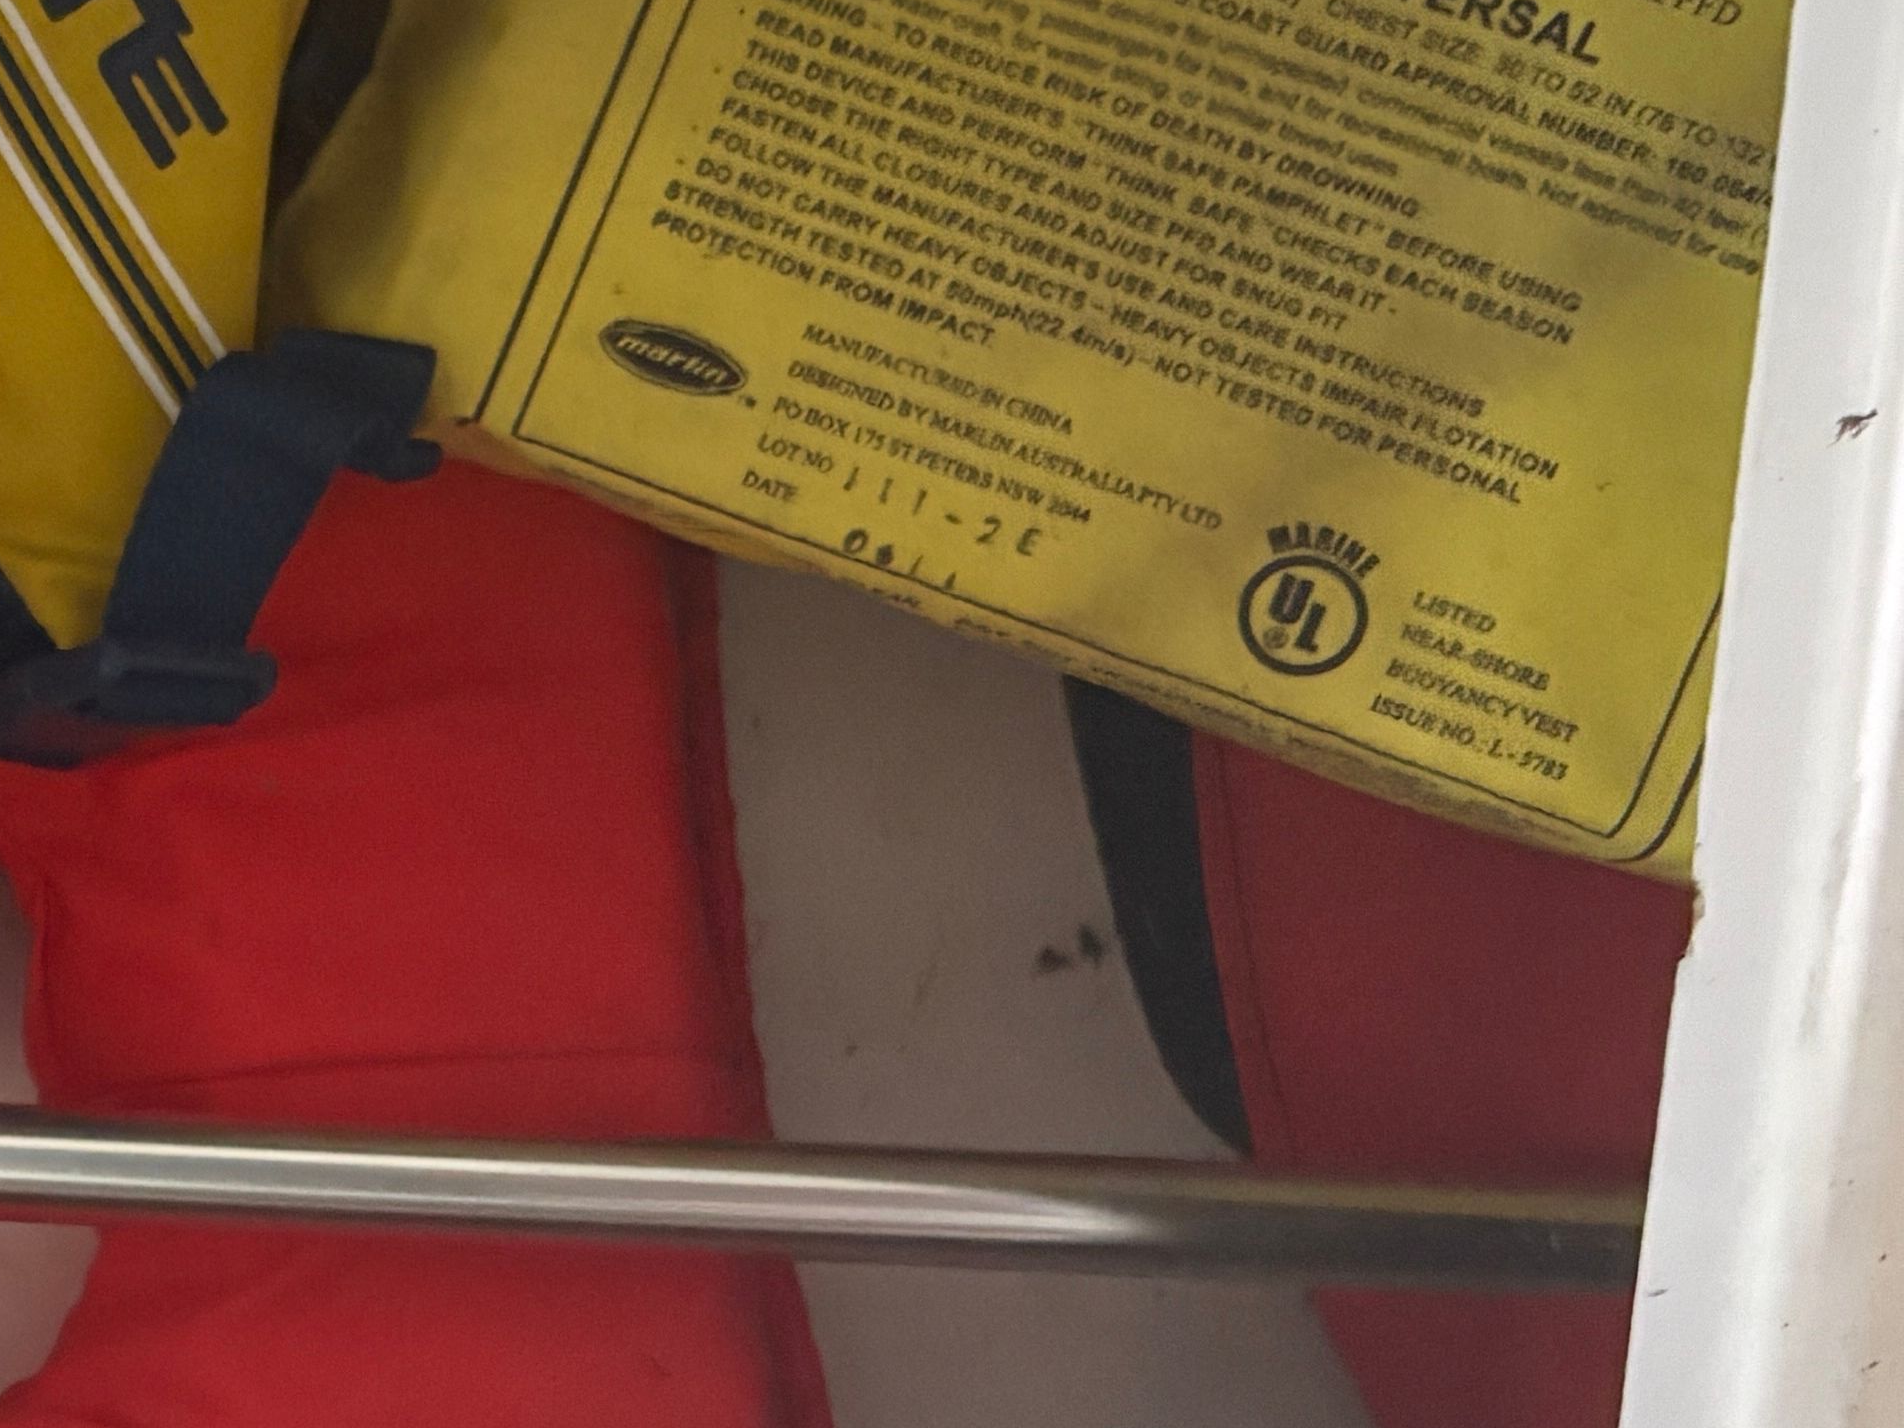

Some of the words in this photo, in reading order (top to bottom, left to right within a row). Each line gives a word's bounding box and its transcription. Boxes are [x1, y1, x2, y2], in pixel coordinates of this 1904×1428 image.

[892, 23, 927, 47] TO
[930, 36, 1039, 85] REDUCE
[1042, 73, 1105, 107] RISK
[1111, 96, 1146, 121] OF
[1149, 109, 1234, 151] DEATH
[1237, 140, 1273, 165] BY
[1294, 27, 1389, 72] GUARD
[1392, 61, 1532, 122] APPROVAL
[1323, 0, 1415, 46] CHEST
[1528, 71, 1564, 97] TO
[1565, 84, 1599, 110] 52
[1602, 97, 1630, 121] IN
[1680, 124, 1715, 150] TO
[721, 99, 817, 144] FASTEN
[820, 133, 868, 162] ALL
[872, 151, 1012, 212] CLOSURES
[1014, 201, 1070, 233] AND
[1071, 221, 1169, 268] ADJUST
[1173, 257, 1227, 288] FOR
[1231, 277, 1303, 315] SNUG
[1308, 305, 1347, 331] FIT
[732, 70, 837, 119] CHOOSE
[844, 108, 891, 137] THE
[896, 126, 975, 166] RIGHT
[982, 156, 1046, 191] TYPE
[1049, 179, 1102, 211] AND
[1105, 199, 1161, 232] SIZE
[1165, 220, 1217, 251] PFD
[1219, 239, 1274, 271] AND
[1278, 260, 1356, 300] WEAR
[1359, 289, 1385, 310] IT
[744, 41, 802, 73] THIS
[804, 61, 897, 105] DEVICE
[900, 94, 957, 125] AND
[960, 114, 1086, 170] PERFORM
[1188, 195, 1253, 231] SAFE
[1384, 265, 1457, 304] EACH
[1463, 293, 1572, 344] SEASON
[756, 11, 826, 48] READ
[1163, 151, 1227, 187] SAFE
[1386, 230, 1494, 280] BEFORE
[1498, 269, 1583, 312] USING
[652, 211, 814, 281] PROTECTION
[819, 270, 893, 309] FROM
[708, 128, 814, 177] FOLLOW
[817, 165, 867, 196] THE
[1104, 267, 1157, 299] USE
[1159, 287, 1214, 319] AND
[1217, 308, 1290, 346] CARE
[1294, 335, 1485, 417] INSTRUCTIONS
[664, 182, 802, 243] STRENGTH
[807, 232, 905, 279] TESTED
[908, 267, 940, 291] AT
[1153, 356, 1207, 388] NOT
[1211, 377, 1313, 426] TESTED
[1317, 415, 1372, 447] FOR
[1377, 437, 1524, 502] PERSONAL
[695, 159, 732, 184] DO
[736, 173, 788, 204] NOT
[792, 193, 879, 236] CARRY
[883, 224, 967, 266] HEAVY
[970, 255, 1087, 309] OBJECTS
[1109, 304, 1195, 348] HEAVY
[1198, 337, 1315, 391] OBJECTS
[1320, 381, 1408, 425] IMPAIR
[1412, 413, 1558, 479] FLOTATION
[802, 325, 977, 400] MANUFACTURED
[980, 389, 1004, 409] IN
[1005, 398, 1075, 434] CHINA
[741, 470, 798, 503] DATE
[756, 434, 800, 462] LOT
[801, 450, 835, 474] NO
[772, 397, 803, 420] PO
[803, 408, 850, 437] BOX
[853, 426, 884, 449] 175
[887, 438, 912, 459] ST
[915, 448, 995, 488] PETERS
[996, 477, 1044, 505] NSW
[787, 361, 897, 413] DESIGNED
[897, 400, 928, 423] BY
[929, 411, 1013, 454] MARLIN
[1014, 441, 1136, 498] AUSTRALIA
[1136, 486, 1178, 513] PTY
[1180, 502, 1223, 530] LTD
[1266, 521, 1382, 580] MARINE
[1401, 625, 1550, 690] NEAR-SHORE
[1412, 592, 1496, 634] LISTED
[1370, 695, 1436, 732] ISSUE
[1386, 660, 1515, 719] BUOYANCY
[1521, 708, 1577, 742] VEST
